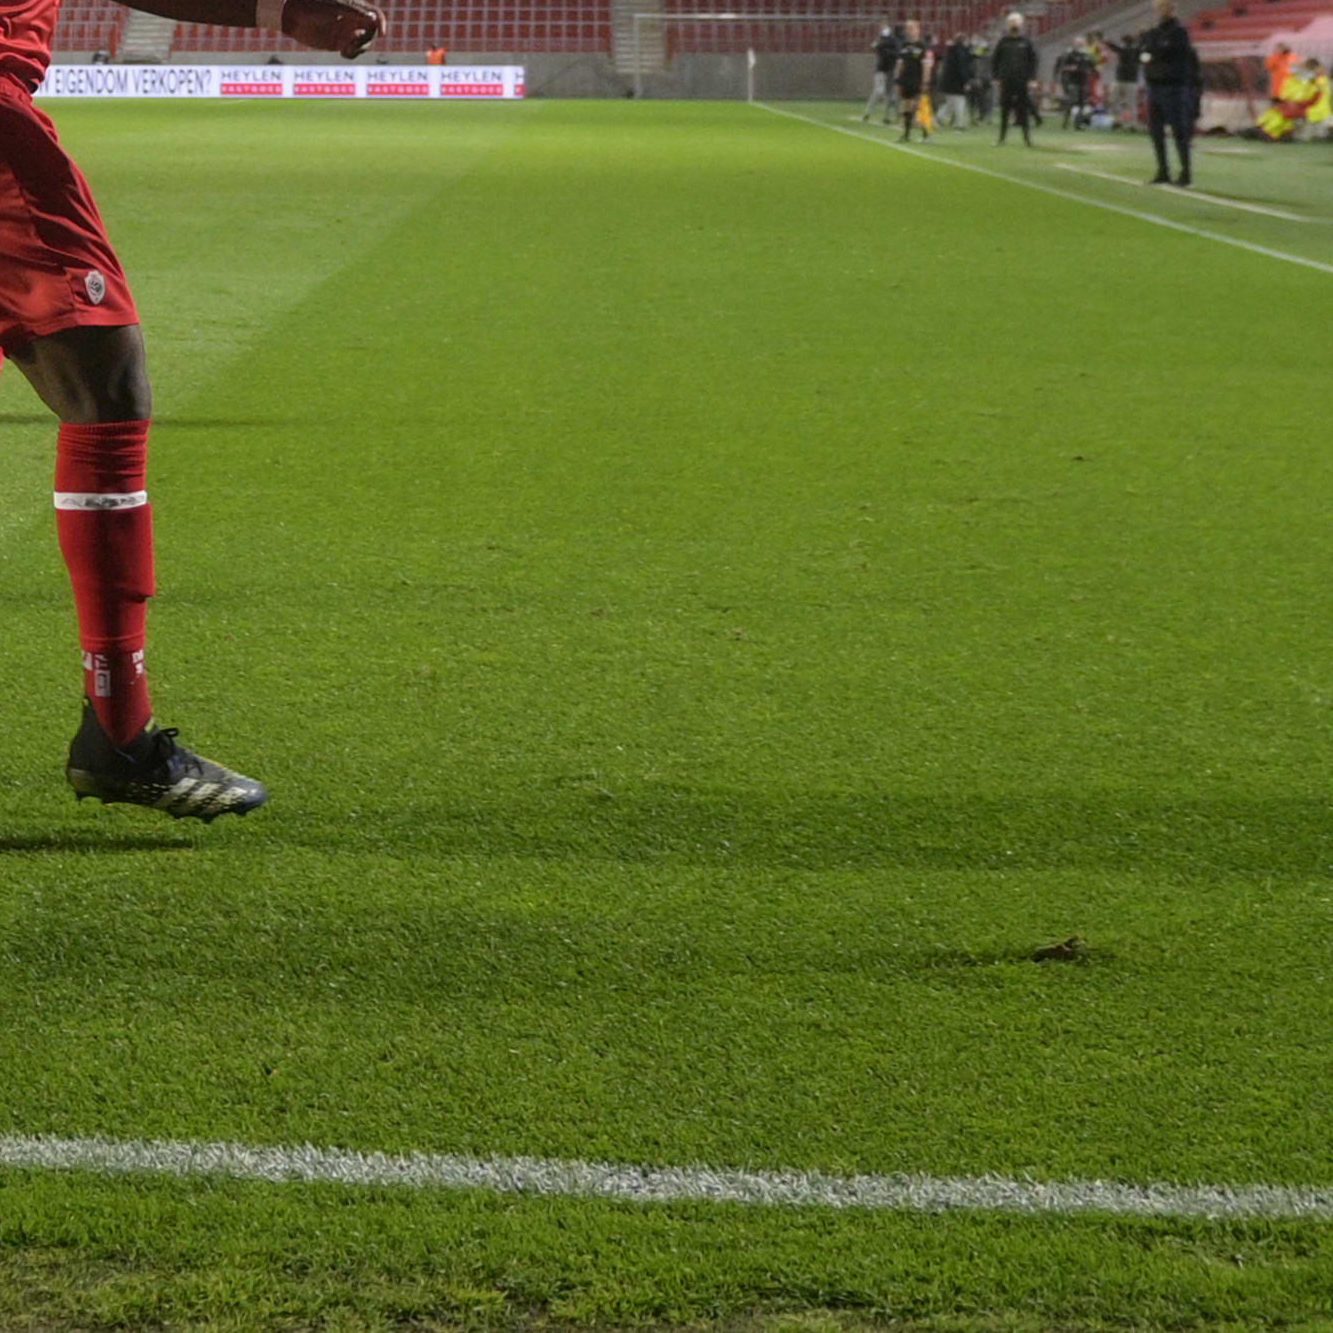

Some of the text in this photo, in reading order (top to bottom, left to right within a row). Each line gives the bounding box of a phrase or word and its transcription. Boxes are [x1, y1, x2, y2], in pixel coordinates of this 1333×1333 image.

[55, 69, 128, 94] EIGENDOM
[133, 69, 213, 94] VERKOPEN?
[221, 71, 282, 82] HEYLEN
[294, 71, 355, 82] HEYLEN
[367, 71, 429, 82] HEYLEN
[441, 71, 502, 82] HEYLEN
